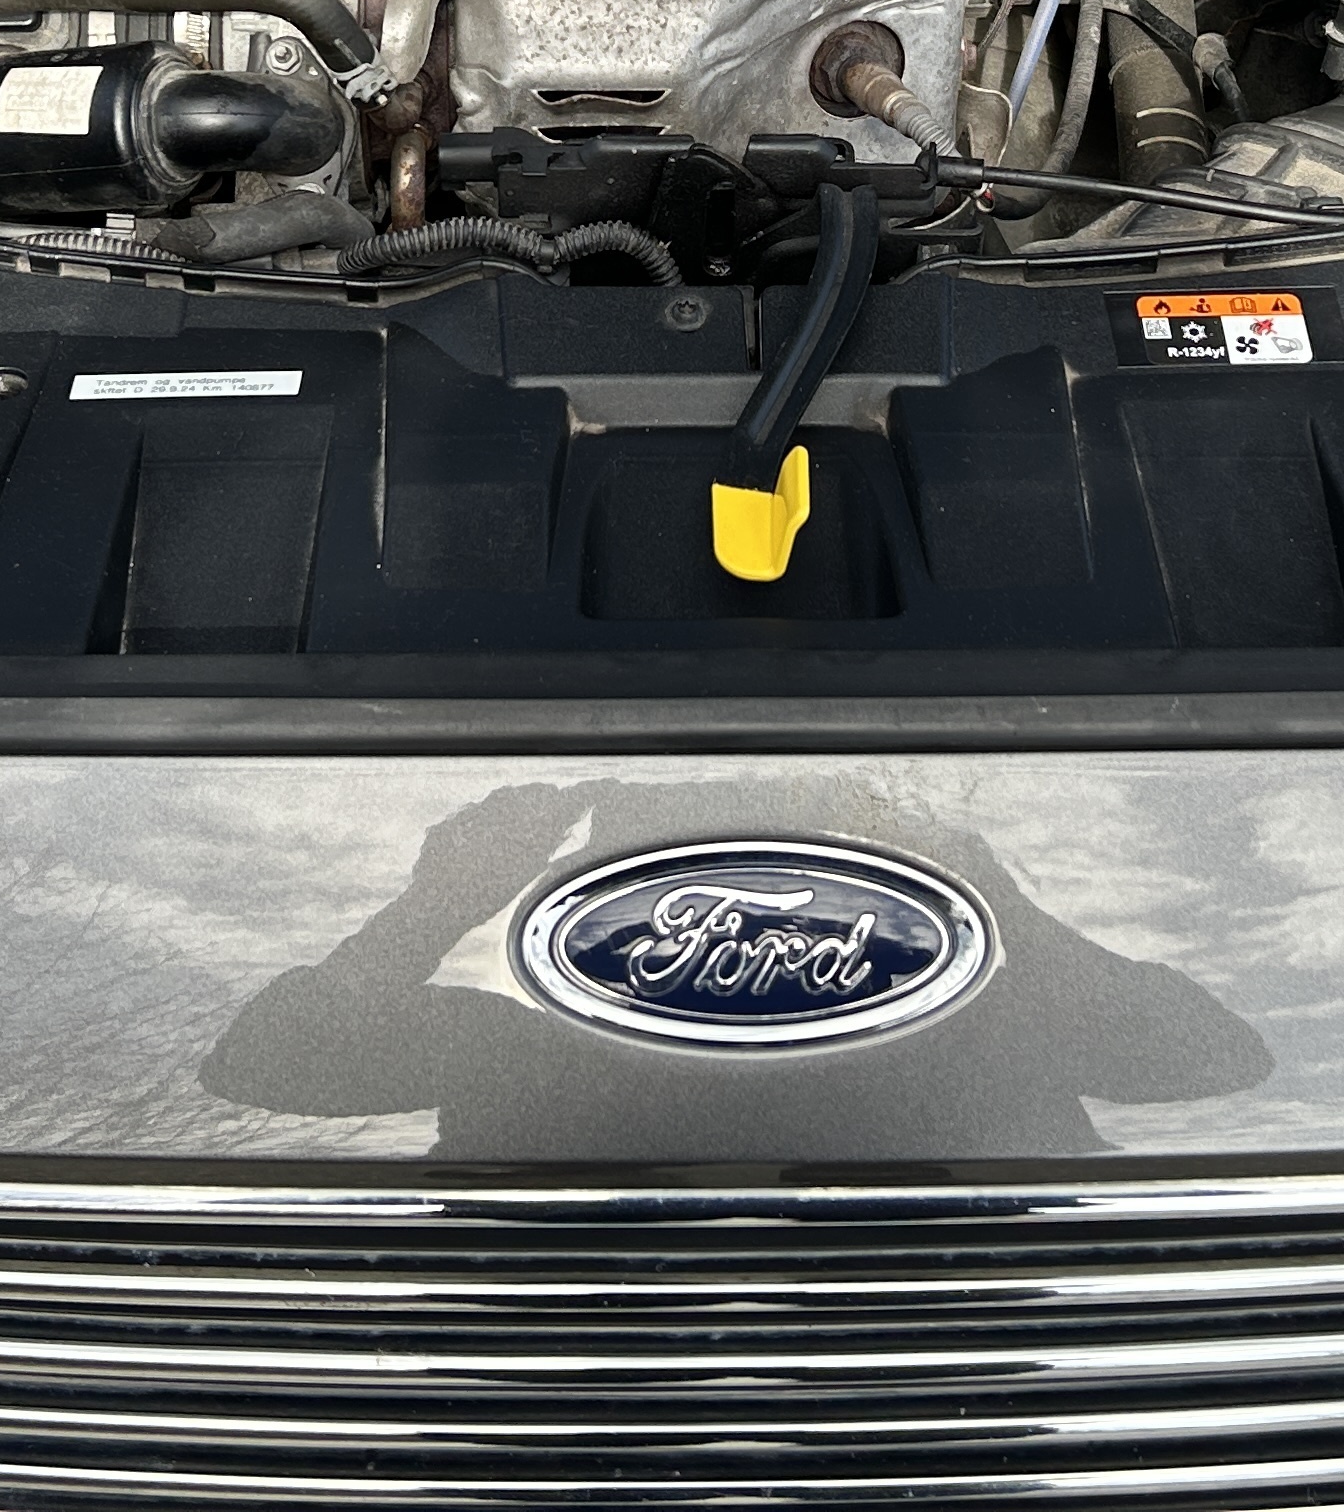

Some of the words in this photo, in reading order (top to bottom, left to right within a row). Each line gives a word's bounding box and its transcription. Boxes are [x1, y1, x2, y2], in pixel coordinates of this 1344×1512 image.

[1167, 346, 1226, 360] R-1234yf
[178, 377, 246, 385] vandpumpe
[628, 885, 877, 996] Ford
